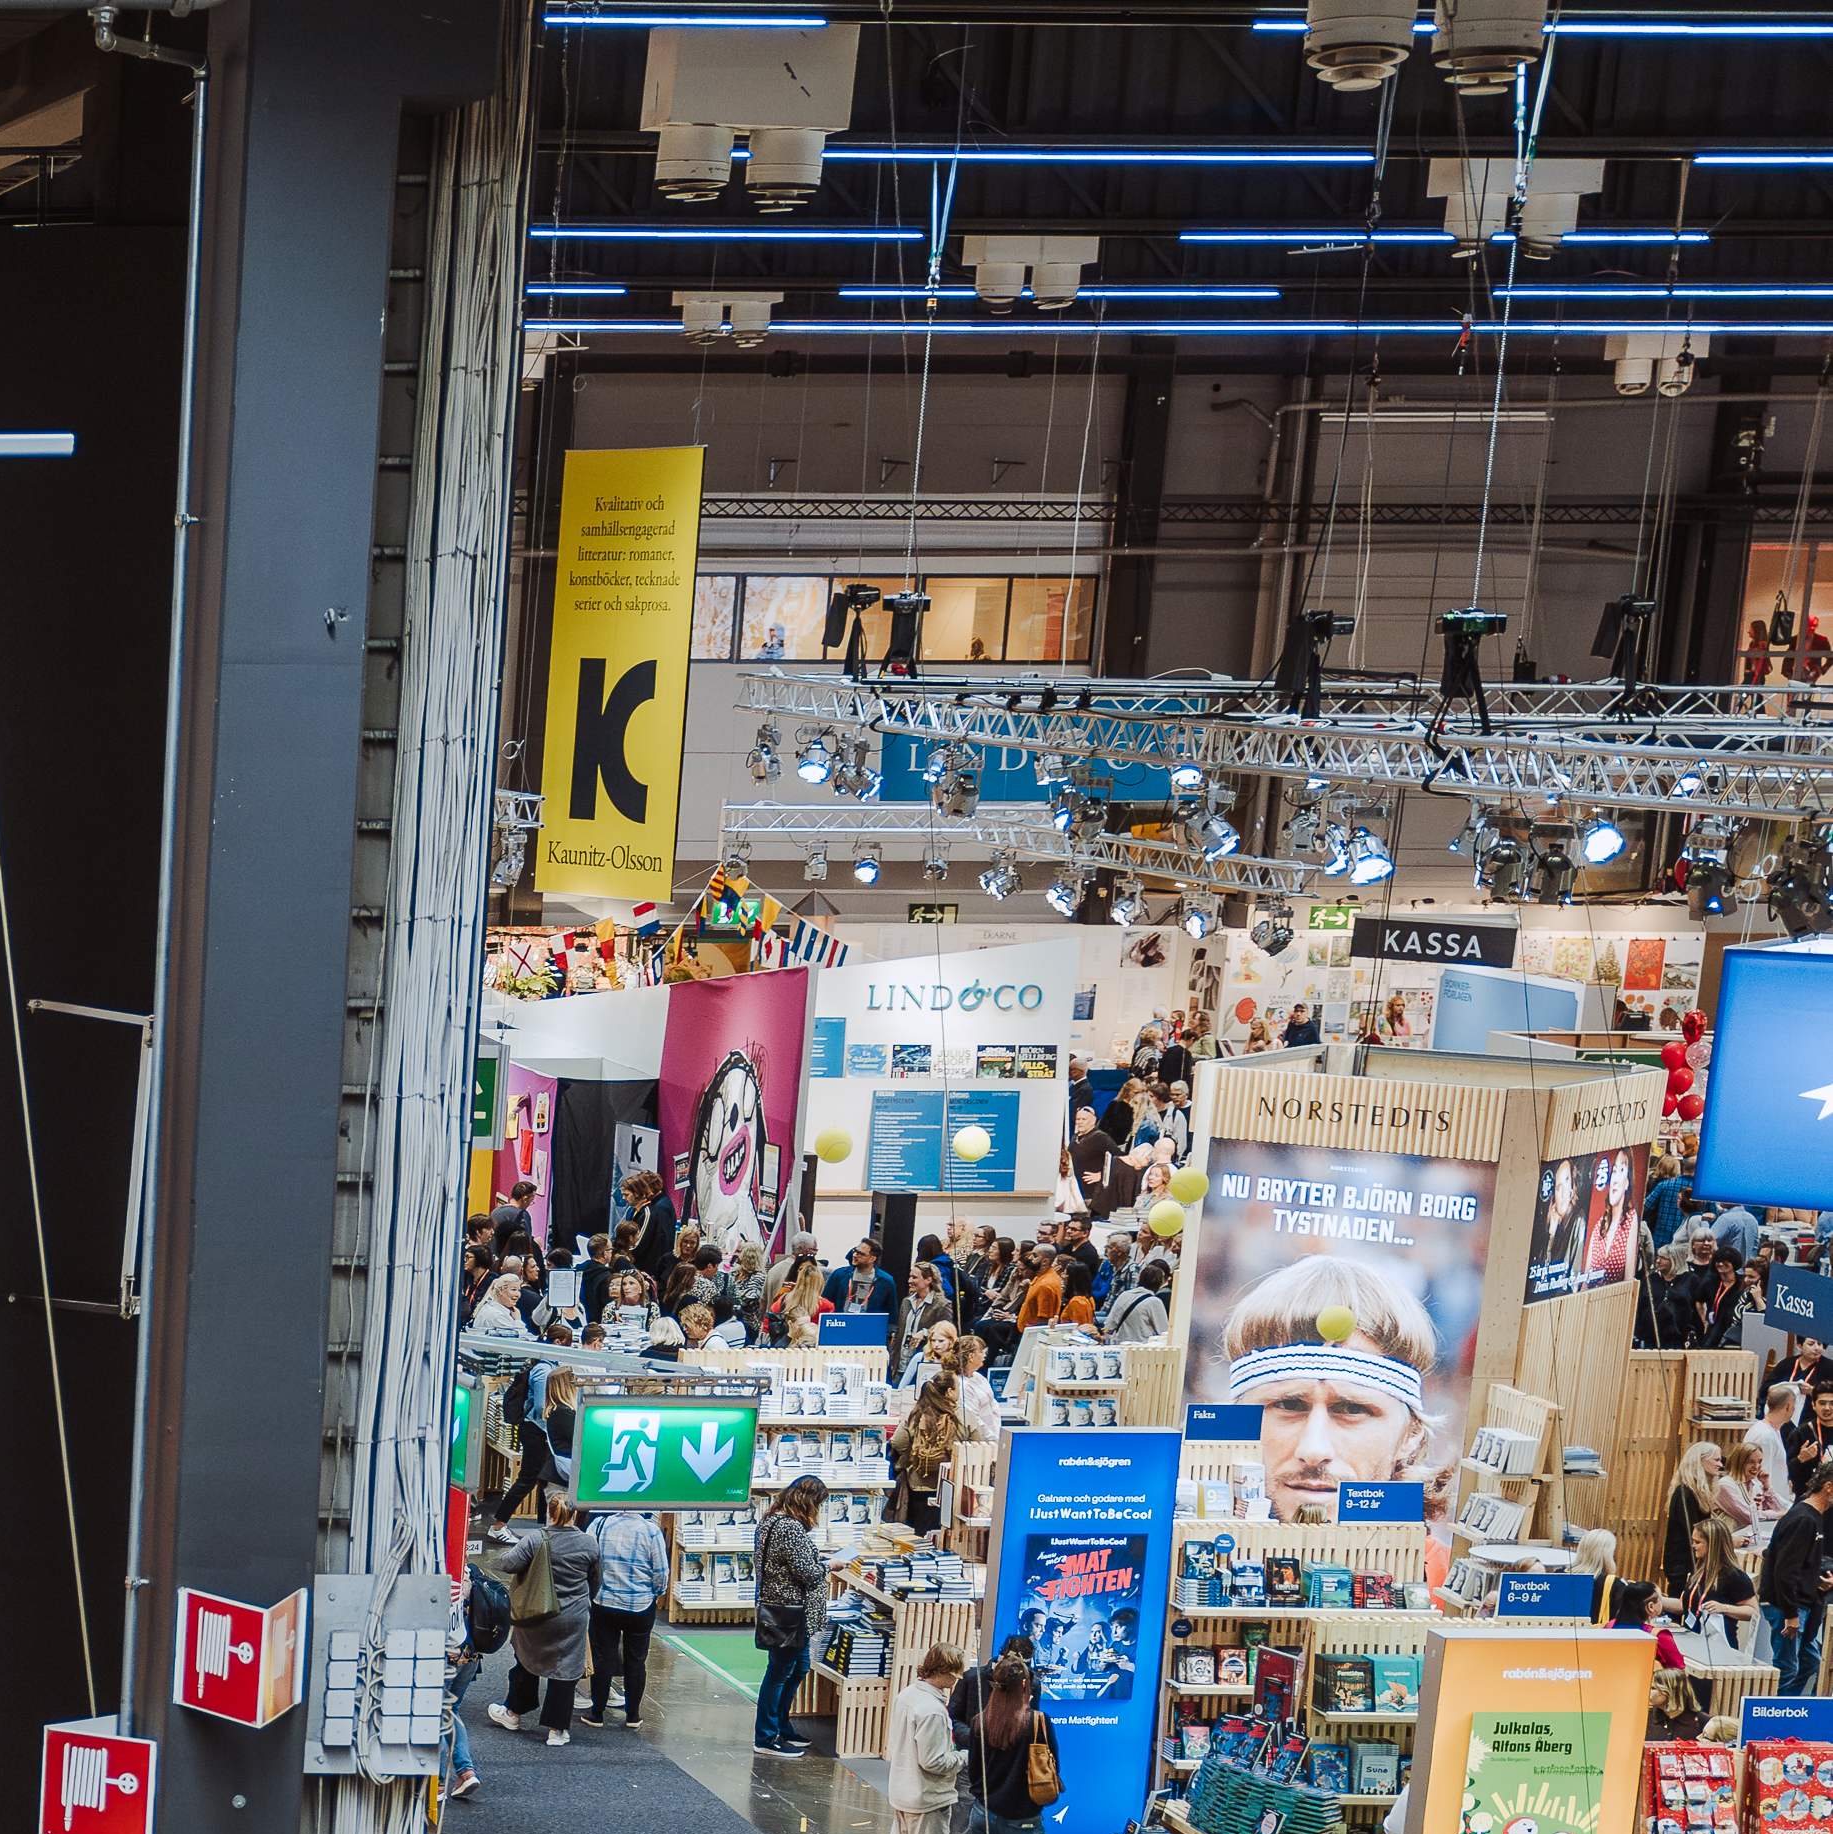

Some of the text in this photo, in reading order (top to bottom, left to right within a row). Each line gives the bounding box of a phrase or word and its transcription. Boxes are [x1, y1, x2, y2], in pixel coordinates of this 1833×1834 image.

[595, 495, 665, 512] Kvalitativ och
[581, 520, 676, 540] samhällsengagerad
[577, 546, 675, 563] litteratur: romaner,
[569, 571, 681, 589] konstböcker, tecknade
[574, 595, 672, 615] serier och sakprosa.
[569, 657, 657, 824] K
[547, 841, 663, 873] Kaunitz-Olsson
[1383, 929, 1482, 959] KASSA
[1258, 1096, 1451, 1132] NORSTEDTS
[1570, 1098, 1649, 1132] NORSTEDTS
[1221, 1173, 1477, 1222] NU BRYTER BJÖRN BORG
[1272, 1208, 1414, 1246] TYSTNADEN...
[1774, 1283, 1814, 1318] Kassa
[825, 1319, 846, 1328] Fakta
[1193, 1410, 1216, 1419] Fakta
[1058, 1456, 1132, 1468] rabén&sjögren
[1037, 1494, 1146, 1504] Galnare och godare med
[1346, 1489, 1385, 1498] Textbok
[1370, 1499, 1381, 1509] år
[1055, 1548, 1112, 1577] MAT
[1035, 1567, 1134, 1602] FIGHTEN
[1508, 1581, 1551, 1591] Textbok
[1531, 1592, 1542, 1603] år
[1503, 1668, 1592, 1682] rabén&sjögren
[1752, 1706, 1809, 1718] Bilderbok
[1068, 1716, 1119, 1727] Matfighten!
[1493, 1721, 1554, 1736] Julkalas,
[1492, 1736, 1573, 1755] Alfons Åberg
